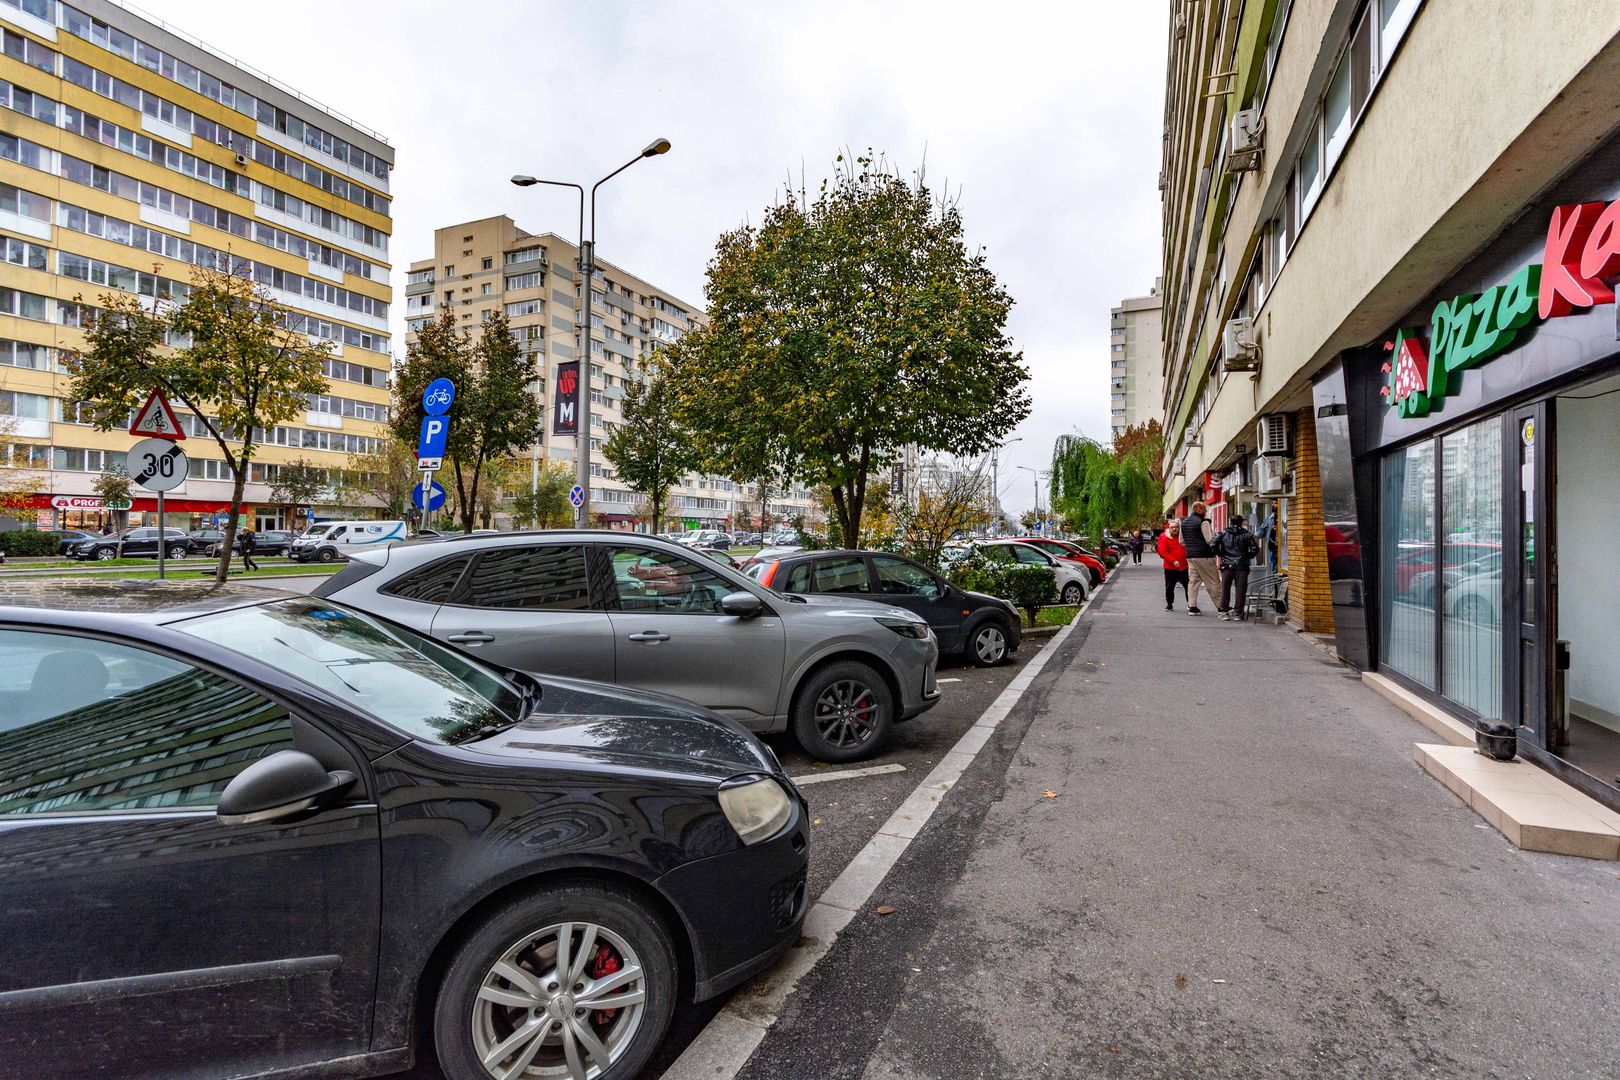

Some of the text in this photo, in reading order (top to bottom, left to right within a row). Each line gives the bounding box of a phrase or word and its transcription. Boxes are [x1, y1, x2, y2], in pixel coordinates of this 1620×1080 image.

[1427, 265, 1533, 399] Pizza
[559, 379, 576, 394] UP
[560, 401, 574, 423] M
[425, 420, 443, 444] P
[143, 453, 174, 478] 30
